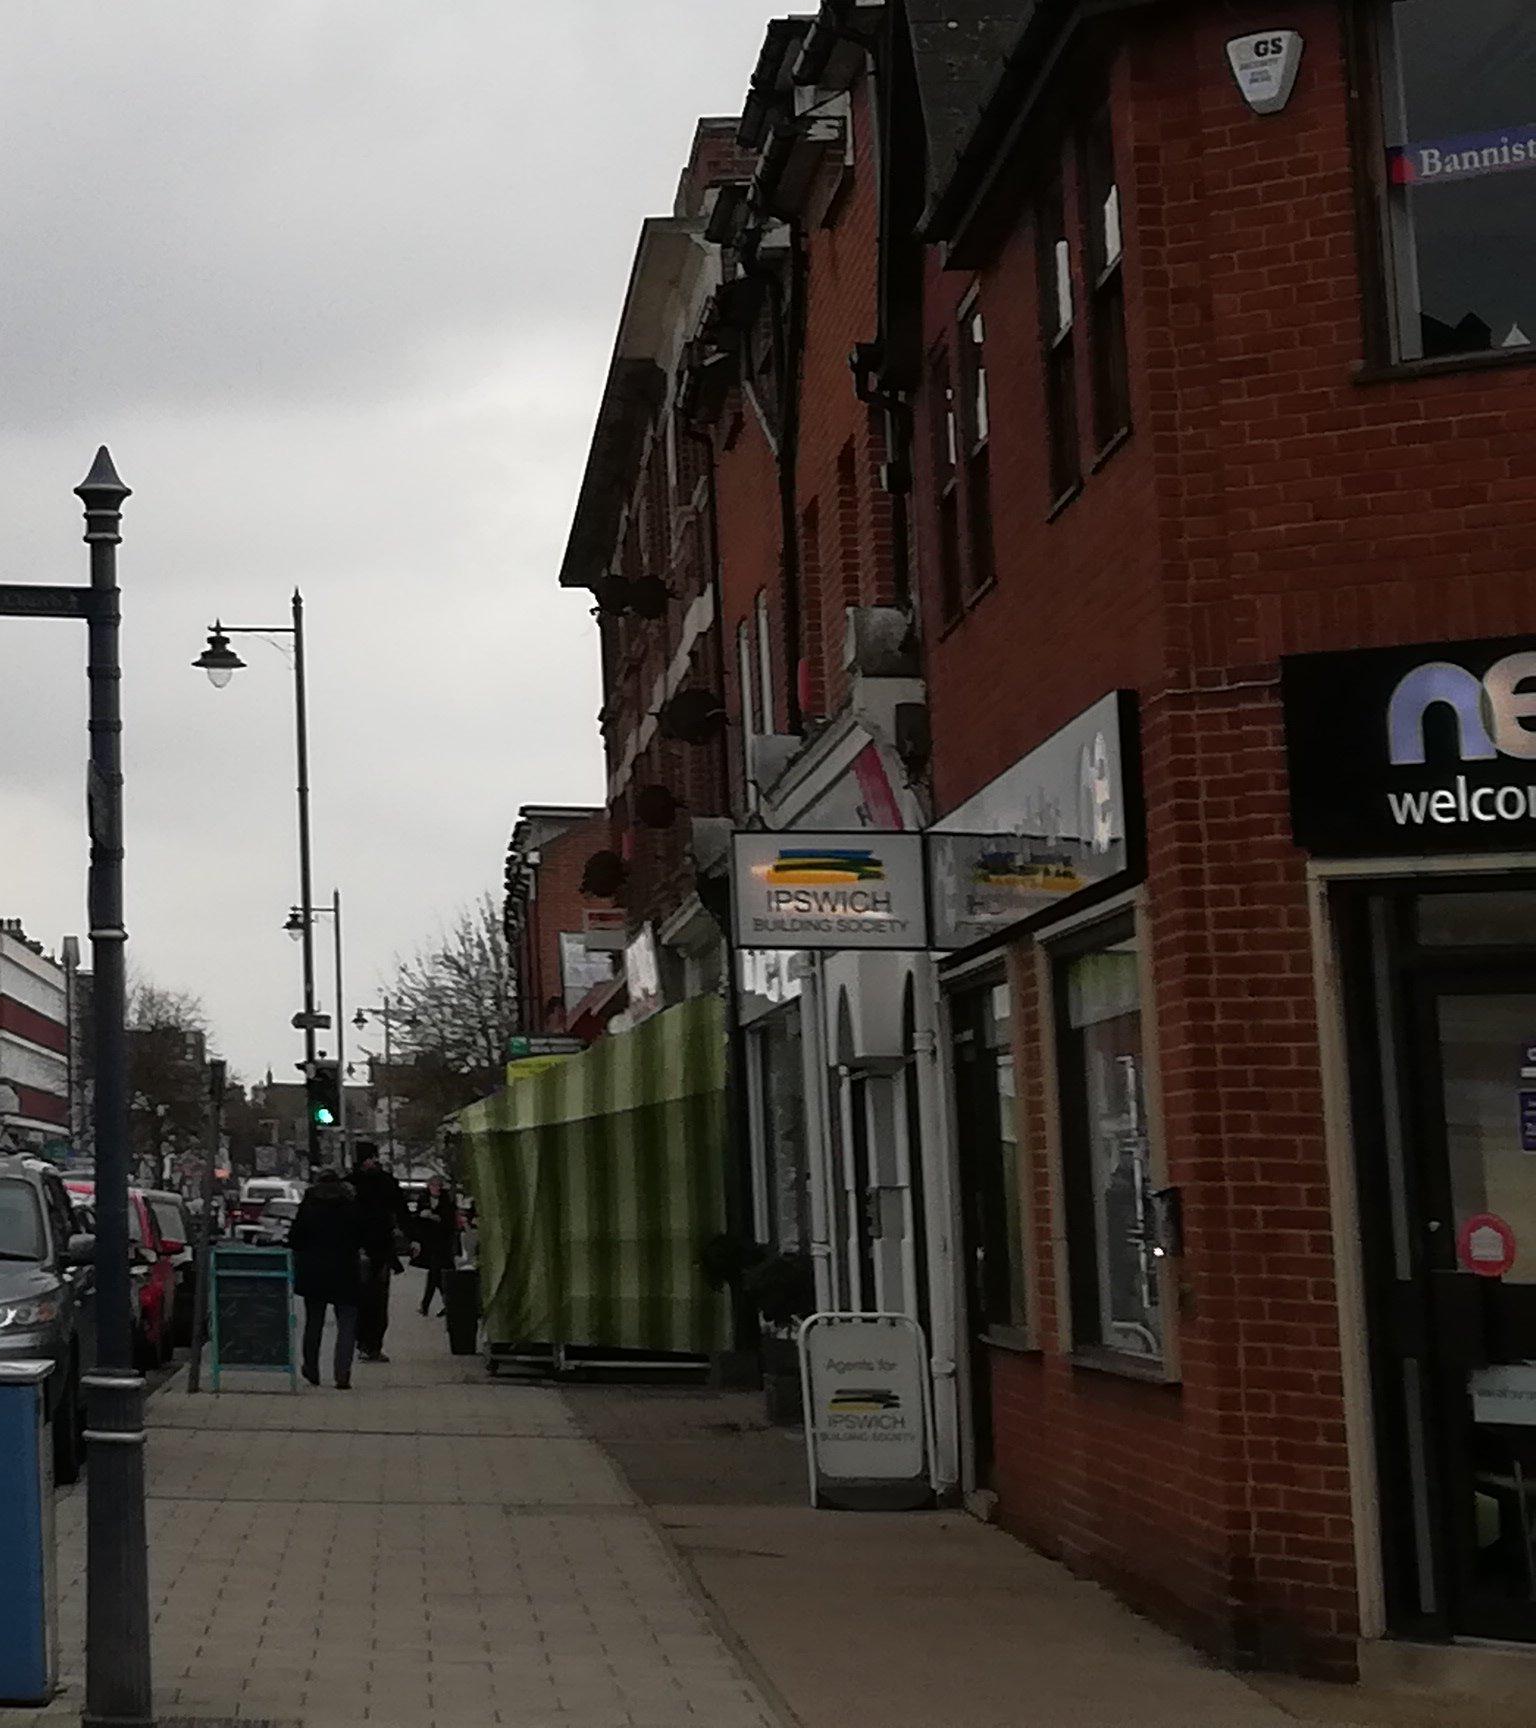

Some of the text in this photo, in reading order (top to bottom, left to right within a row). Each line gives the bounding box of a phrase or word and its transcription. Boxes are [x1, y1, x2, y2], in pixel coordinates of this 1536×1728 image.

[1253, 37, 1284, 58] GS
[766, 890, 892, 914] IPSWICH
[752, 918, 910, 934] BUILDING SOCIETY
[827, 1414, 906, 1430] IPSWICH
